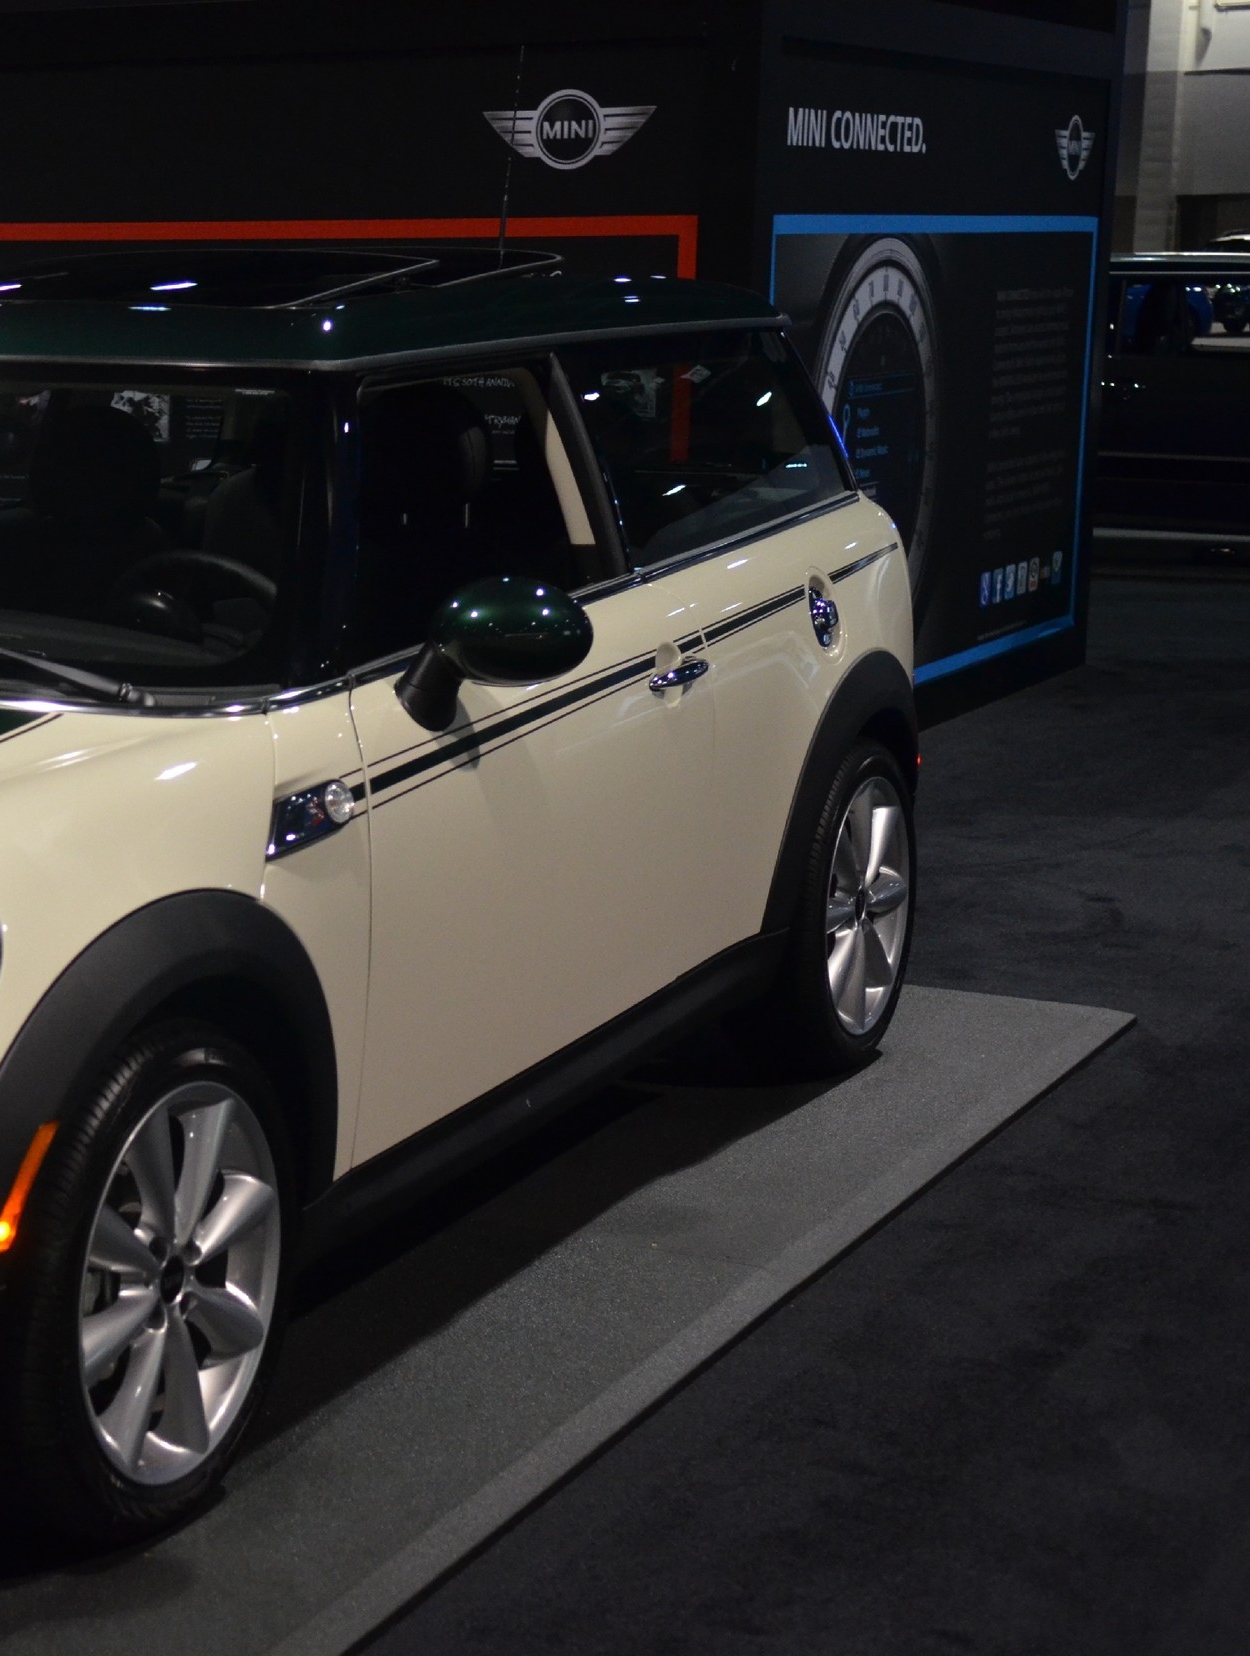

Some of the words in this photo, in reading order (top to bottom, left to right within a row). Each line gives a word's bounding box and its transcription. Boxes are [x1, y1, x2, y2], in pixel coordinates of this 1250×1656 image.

[542, 119, 594, 140] MINI
[787, 107, 827, 147] MINI
[831, 110, 926, 154] CONNECTED.
